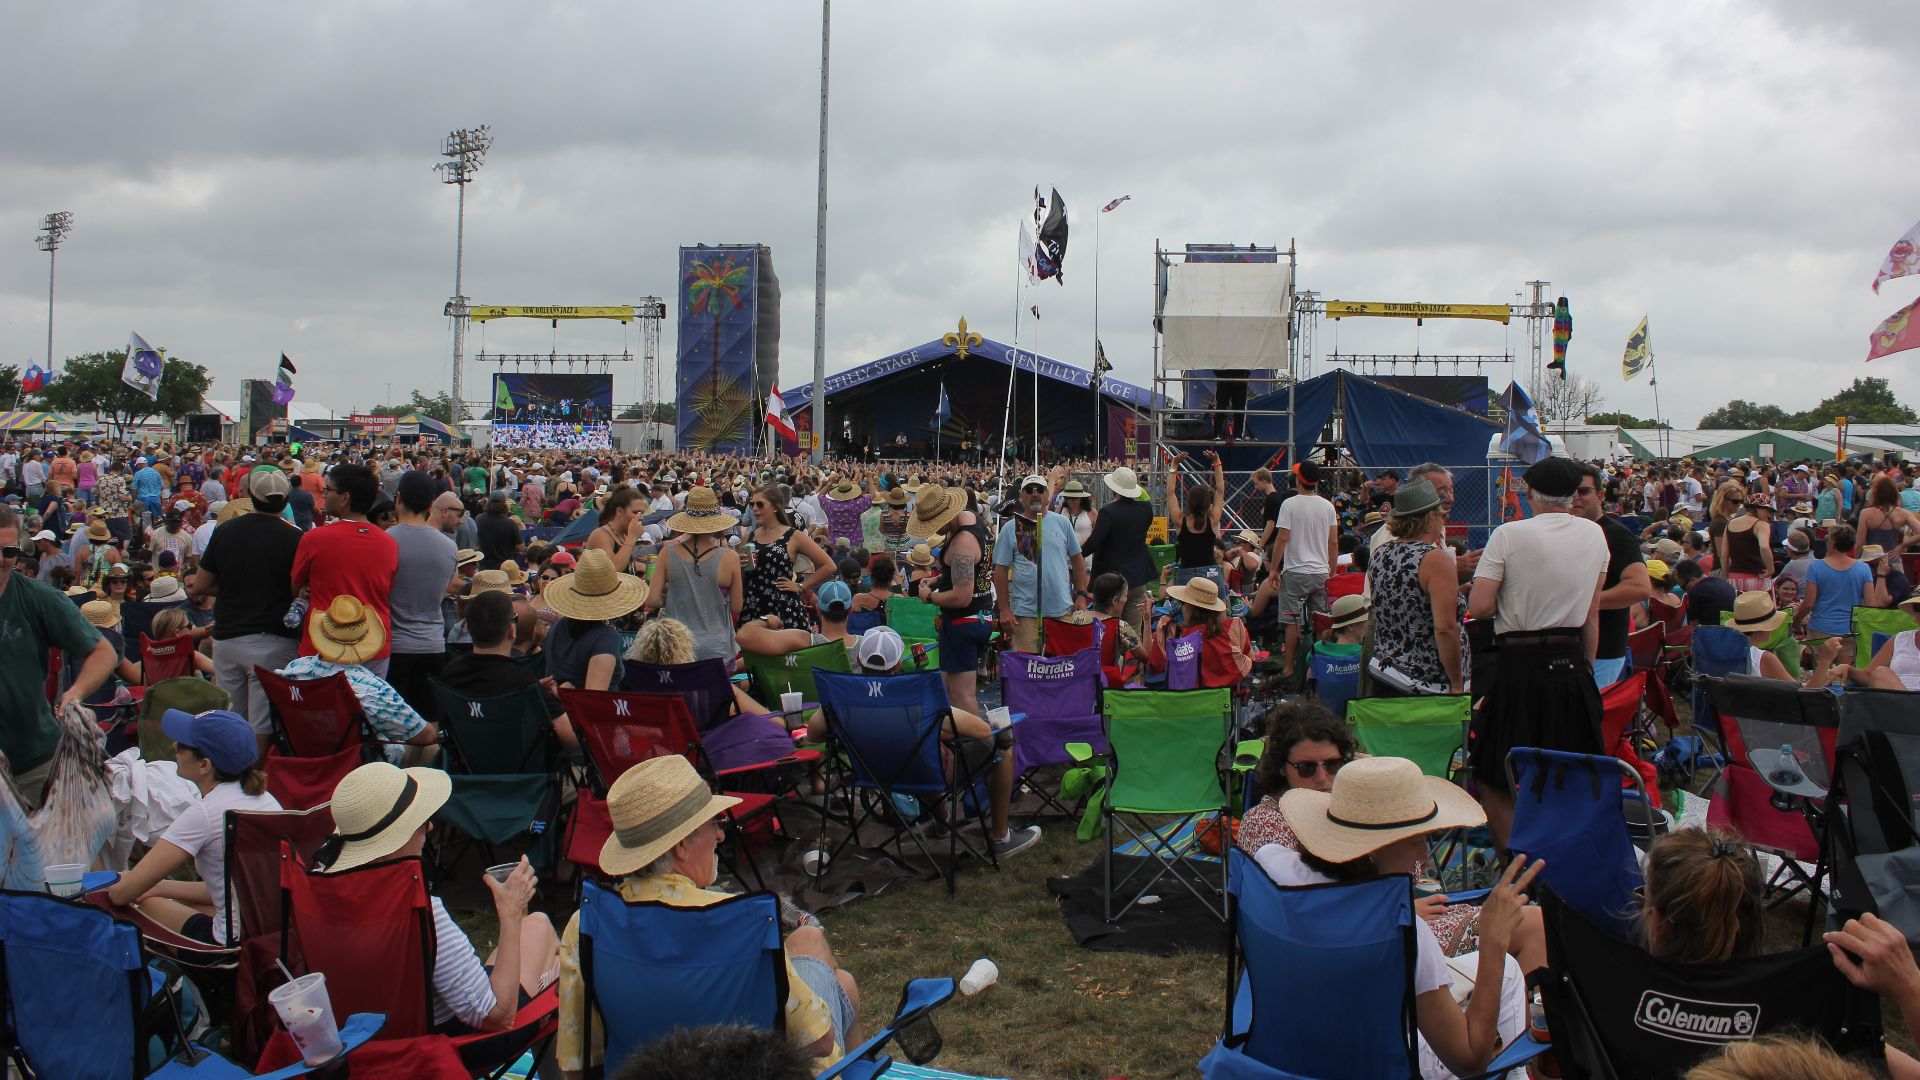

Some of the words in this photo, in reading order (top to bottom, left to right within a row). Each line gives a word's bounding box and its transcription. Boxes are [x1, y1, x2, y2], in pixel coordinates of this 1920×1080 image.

[801, 367, 870, 399] GNTILLY
[874, 350, 920, 375] STAGE
[1005, 349, 1080, 382] GENTILLY
[1083, 373, 1132, 399] SAGE
[1046, 672, 1074, 680] ORLEANS
[1646, 998, 1732, 1033] Coleman
